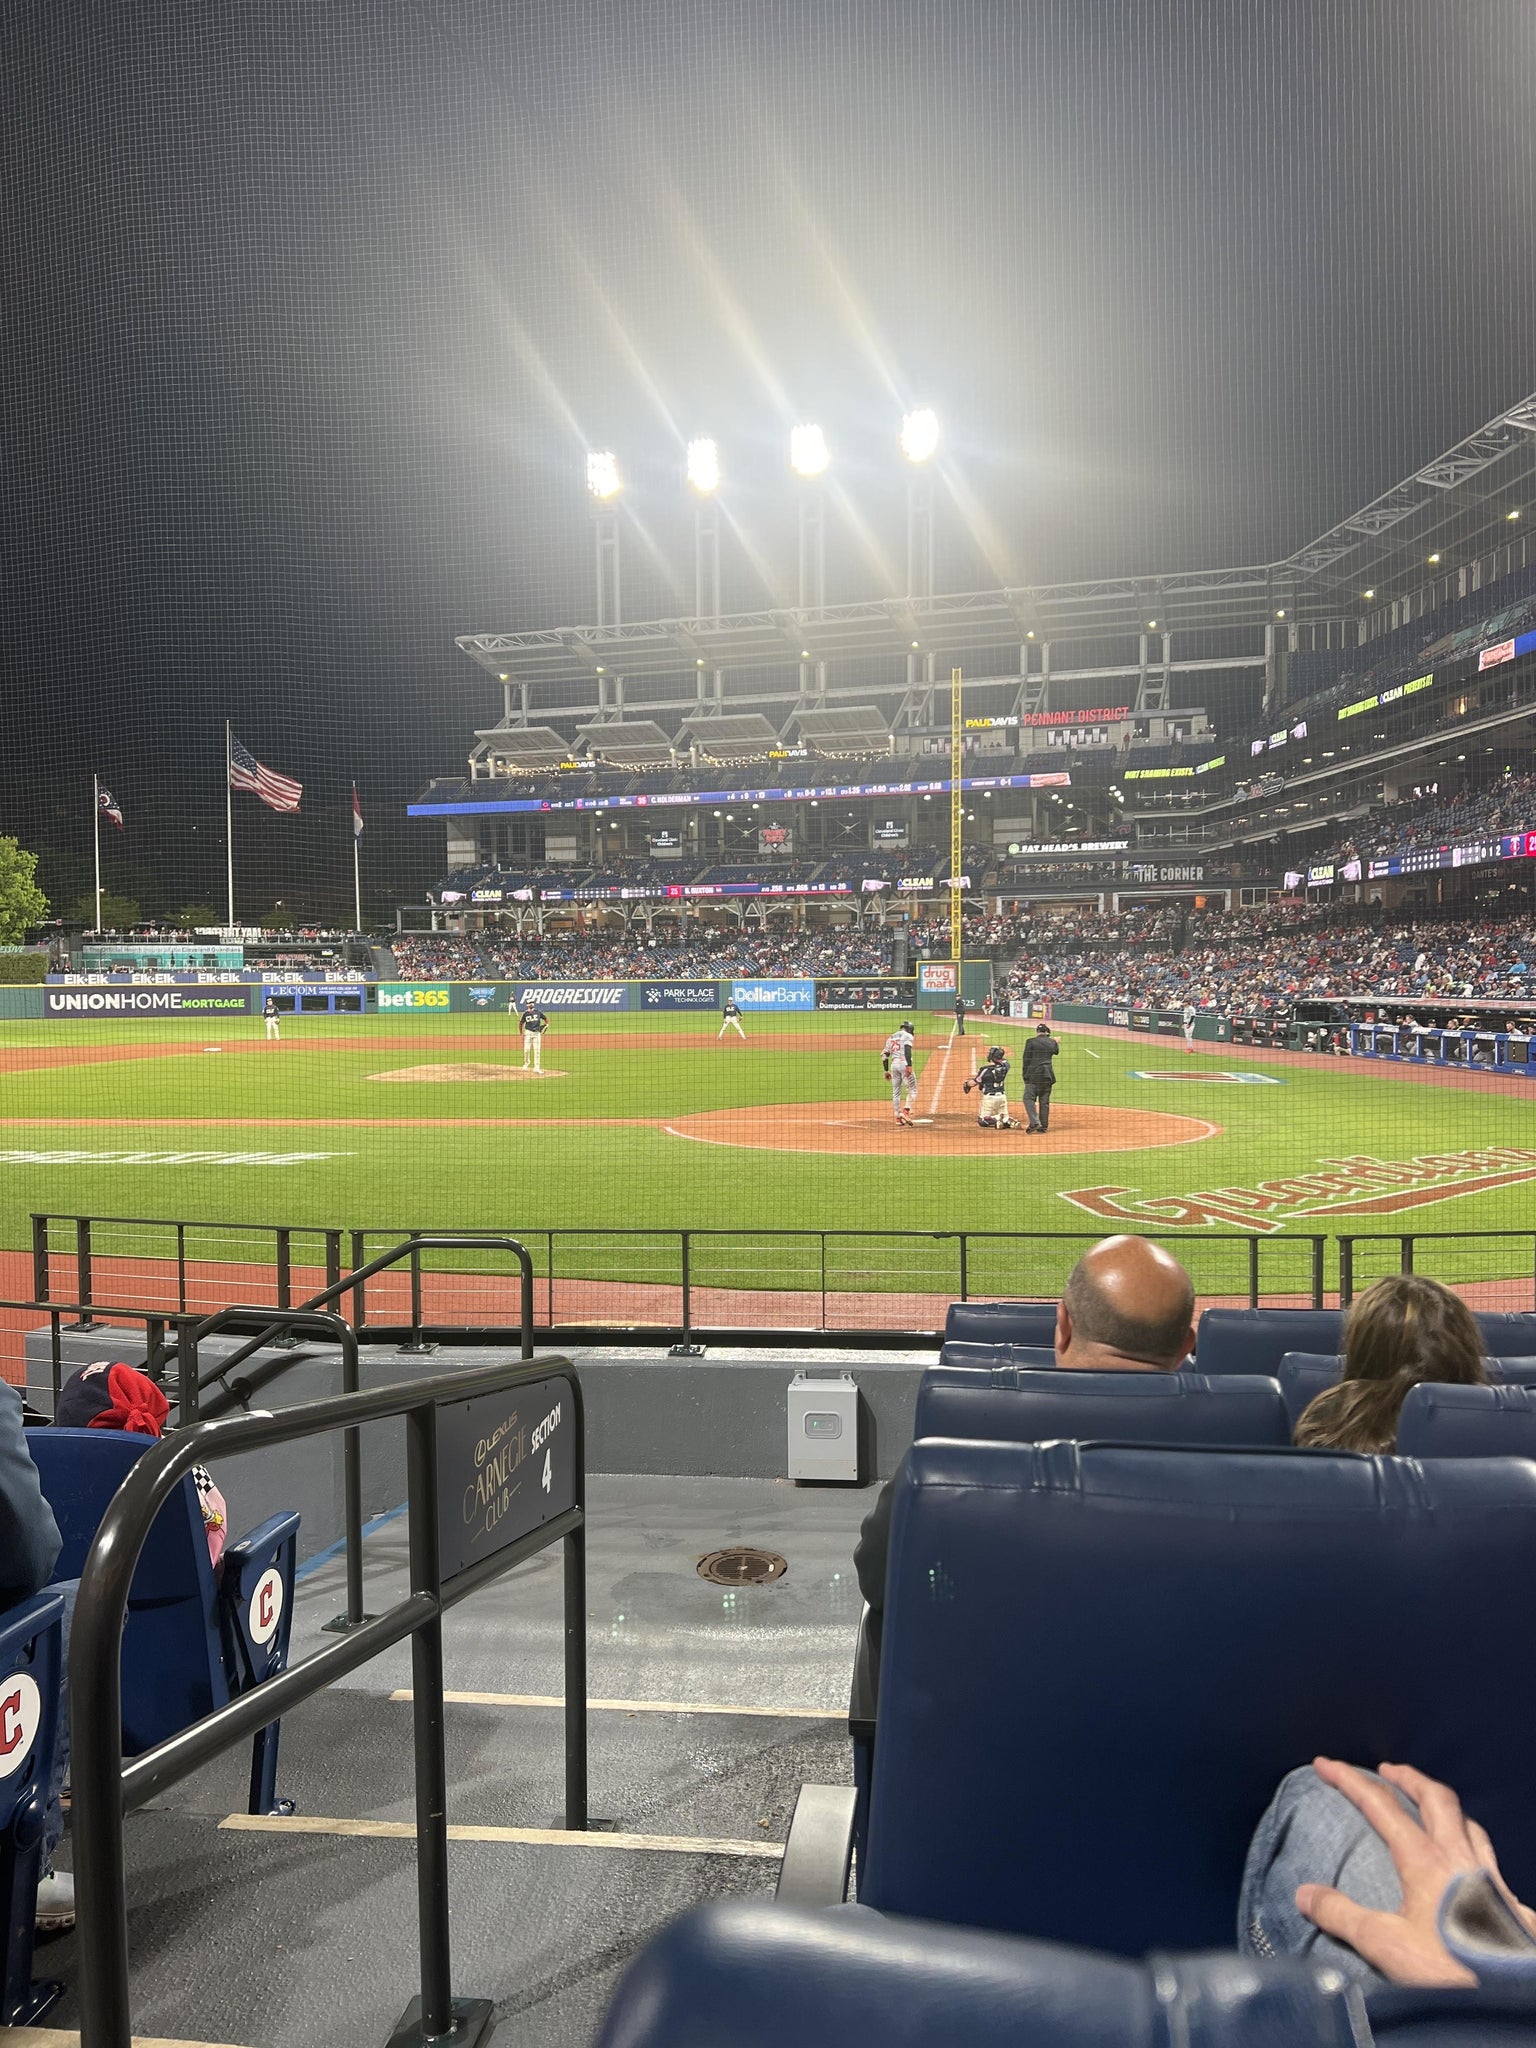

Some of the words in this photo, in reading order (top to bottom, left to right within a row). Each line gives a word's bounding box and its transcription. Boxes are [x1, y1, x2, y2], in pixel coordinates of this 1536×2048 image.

[1023, 711, 1076, 727] PENNANT
[1078, 706, 1129, 723] DISTRICT
[1138, 867, 1158, 882] THE
[1160, 866, 1204, 881] CORNER
[901, 878, 933, 887] CLEAN
[923, 966, 950, 981] drug
[926, 979, 956, 988] mart
[378, 990, 450, 1007] bet365
[519, 988, 623, 1004] PROGRESSIVE
[663, 988, 685, 997] PARK
[687, 988, 714, 997] PLACE
[182, 998, 245, 1008] MORTGAGE
[525, 1014, 539, 1023] CLE
[890, 1040, 901, 1052] 25
[486, 1409, 518, 1450] LEXUS
[531, 1402, 561, 1455] SECTION
[463, 1423, 528, 1525] CARNEGIE
[541, 1447, 552, 1494] 4
[485, 1487, 510, 1532] CLUB
[259, 1579, 273, 1628] C
[0, 1689, 23, 1756] C
